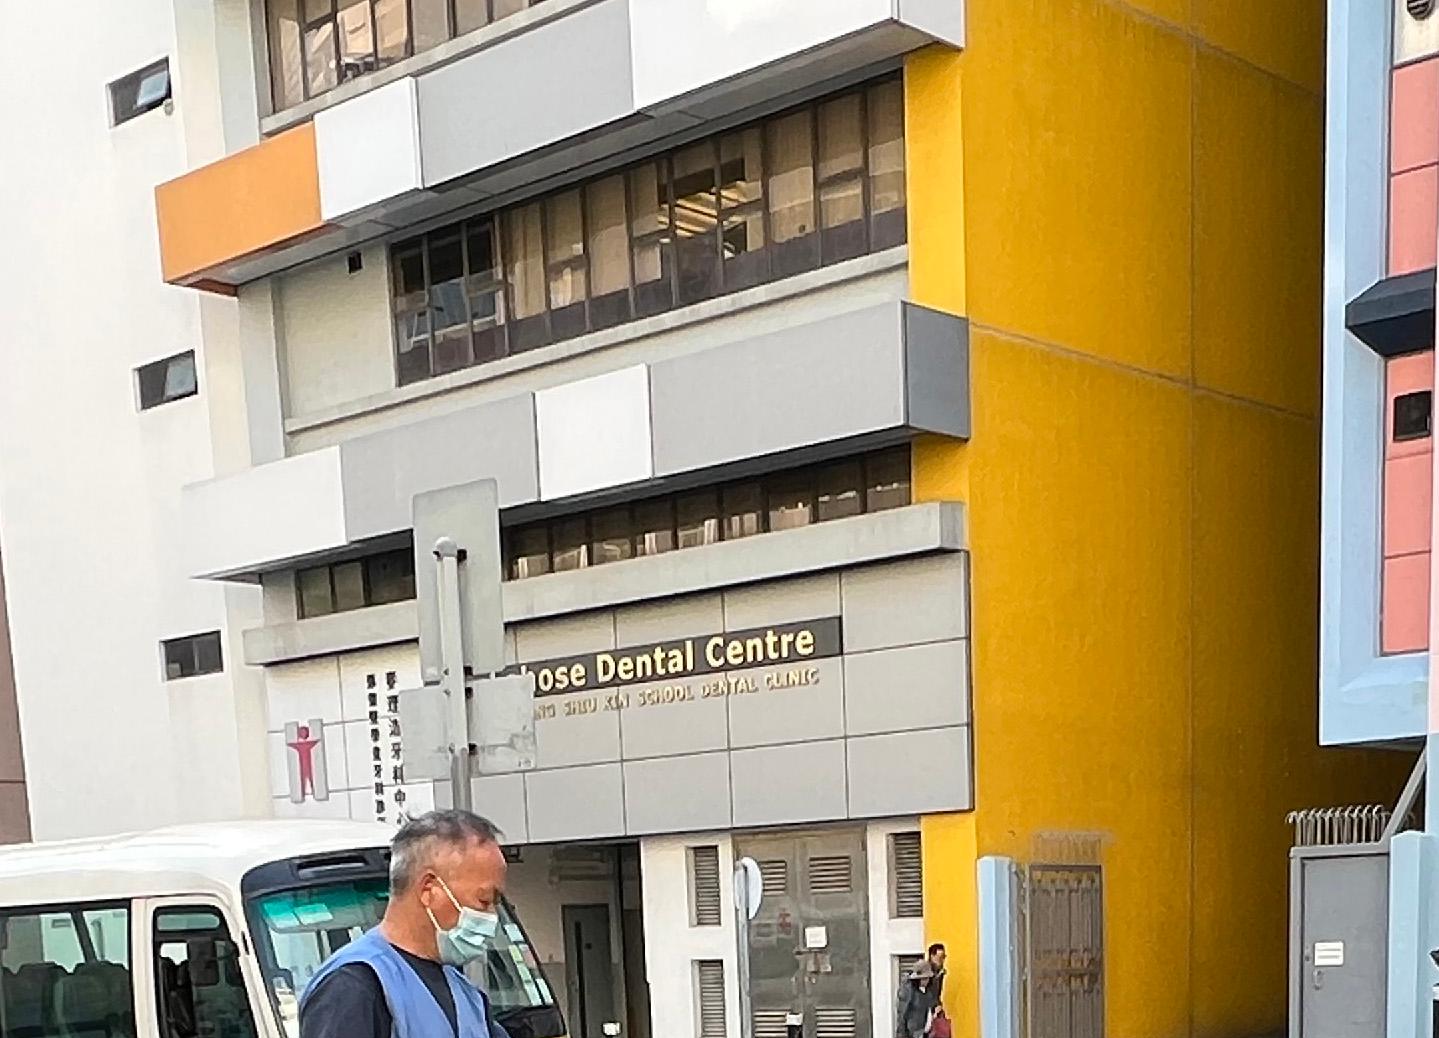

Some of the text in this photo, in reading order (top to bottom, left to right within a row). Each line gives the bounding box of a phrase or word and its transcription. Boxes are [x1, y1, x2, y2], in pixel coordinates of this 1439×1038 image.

[596, 640, 695, 683] Dental
[705, 630, 815, 669] Centre
[638, 685, 695, 707] SCHOOL
[701, 674, 759, 699] DENTAL
[765, 667, 820, 689] CLINIC
